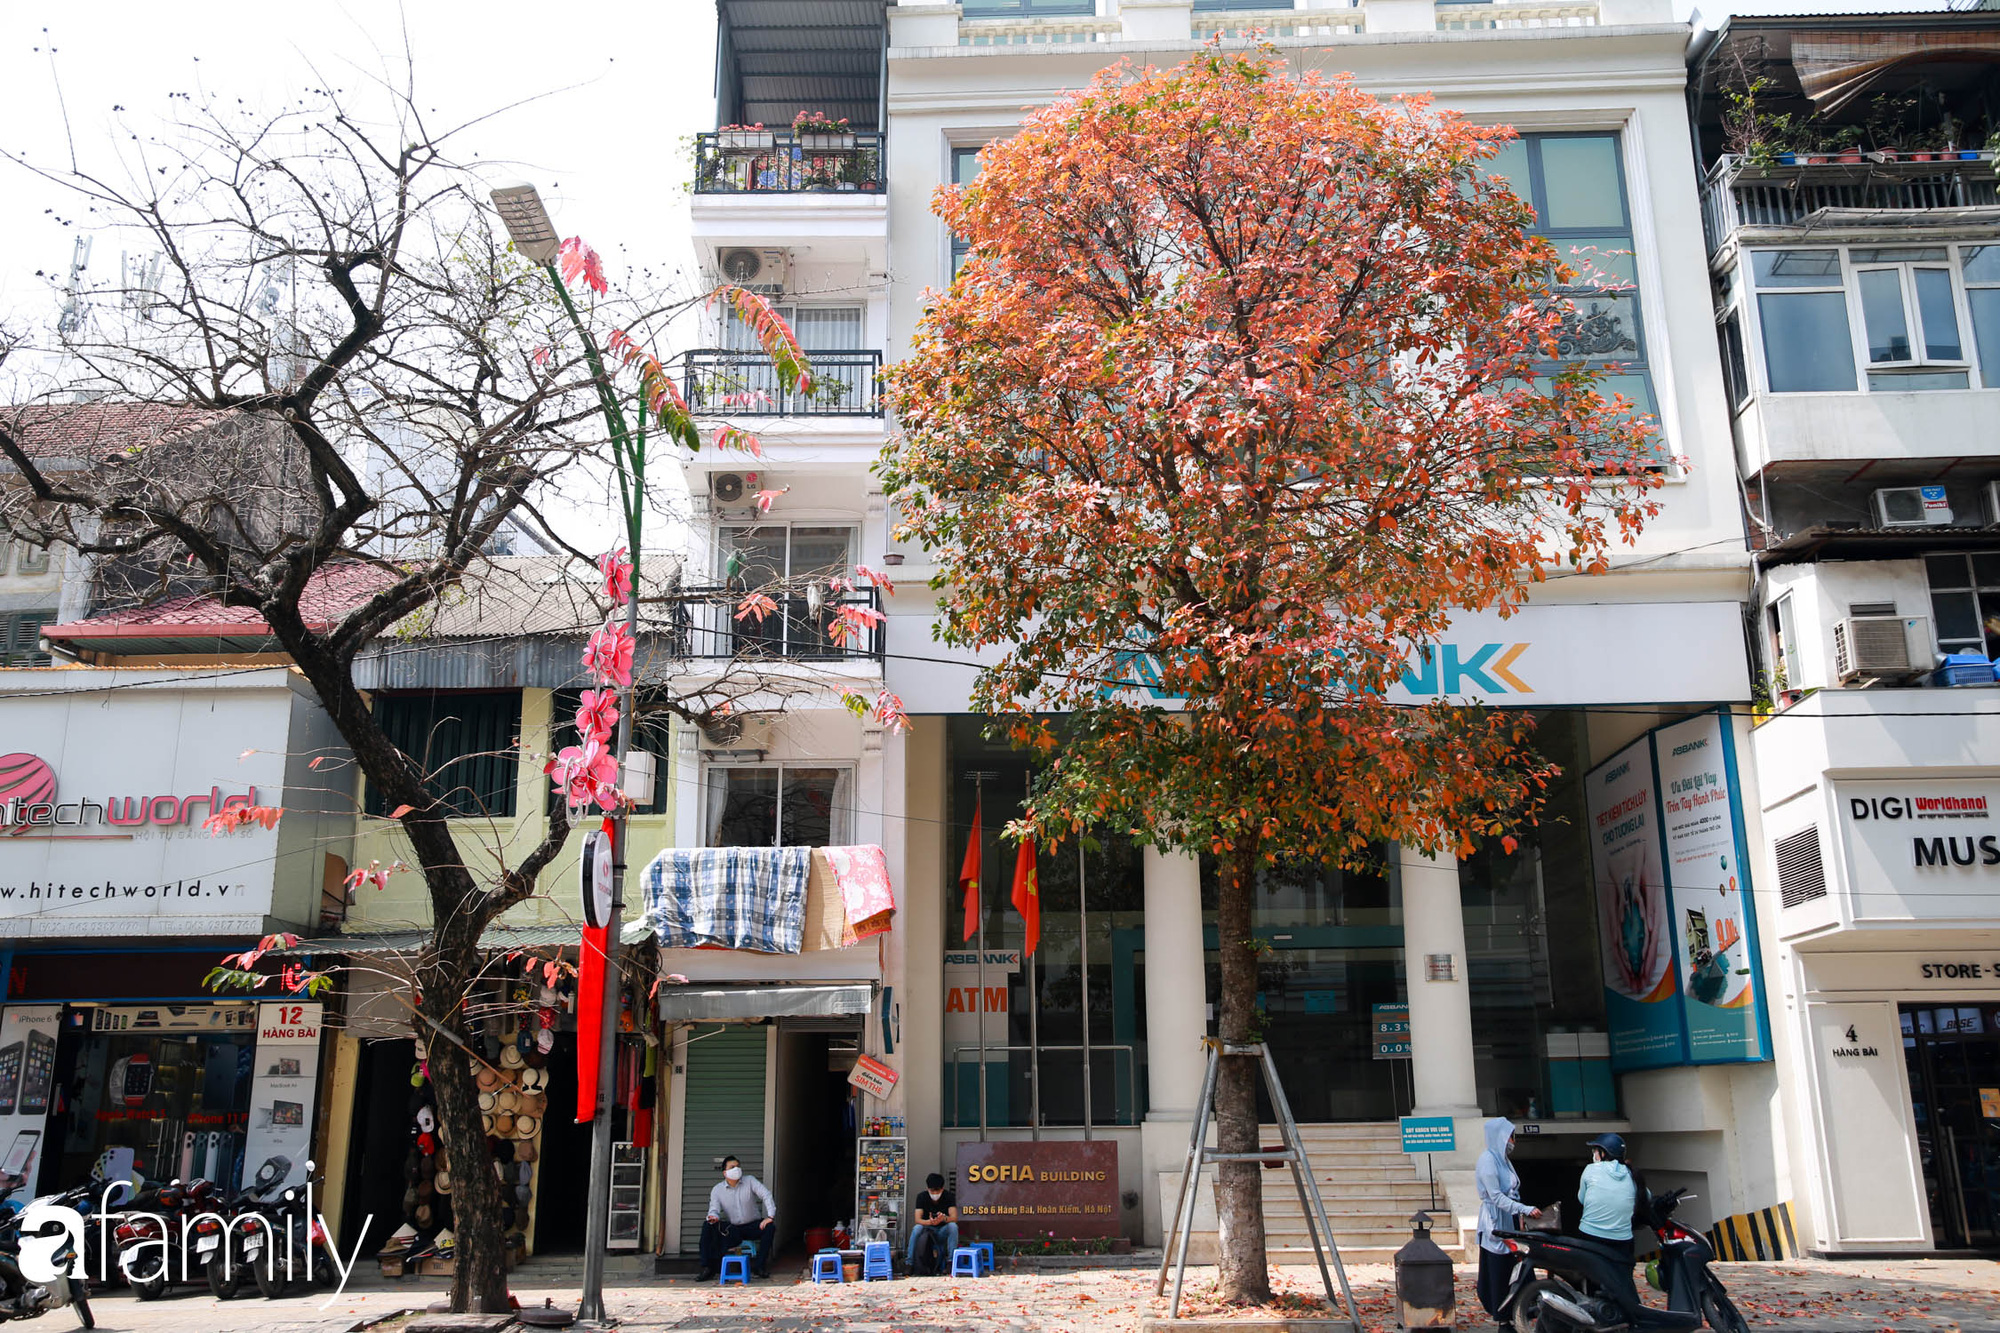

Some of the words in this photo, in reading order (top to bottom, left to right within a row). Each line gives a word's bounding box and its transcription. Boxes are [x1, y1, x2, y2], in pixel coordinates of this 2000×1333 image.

[1850, 797, 1913, 820] DIGI
[946, 988, 1008, 1012] ATM
[19, 1015, 45, 1023] iPhone
[279, 1006, 303, 1024] 12
[263, 1027, 294, 1038] HÀNG
[298, 1027, 316, 1037] BÀI
[1846, 1024, 1858, 1042] 4
[1832, 1047, 1860, 1057] HÀNG
[1862, 1046, 1878, 1056] BÀI
[855, 1075, 868, 1087] SIM
[968, 1165, 1034, 1182] SOFIA
[1040, 1171, 1106, 1182] BUILDING
[998, 1205, 1018, 1216] Hàng
[1037, 1204, 1057, 1214] Hoàn
[1084, 1204, 1096, 1213] Hà
